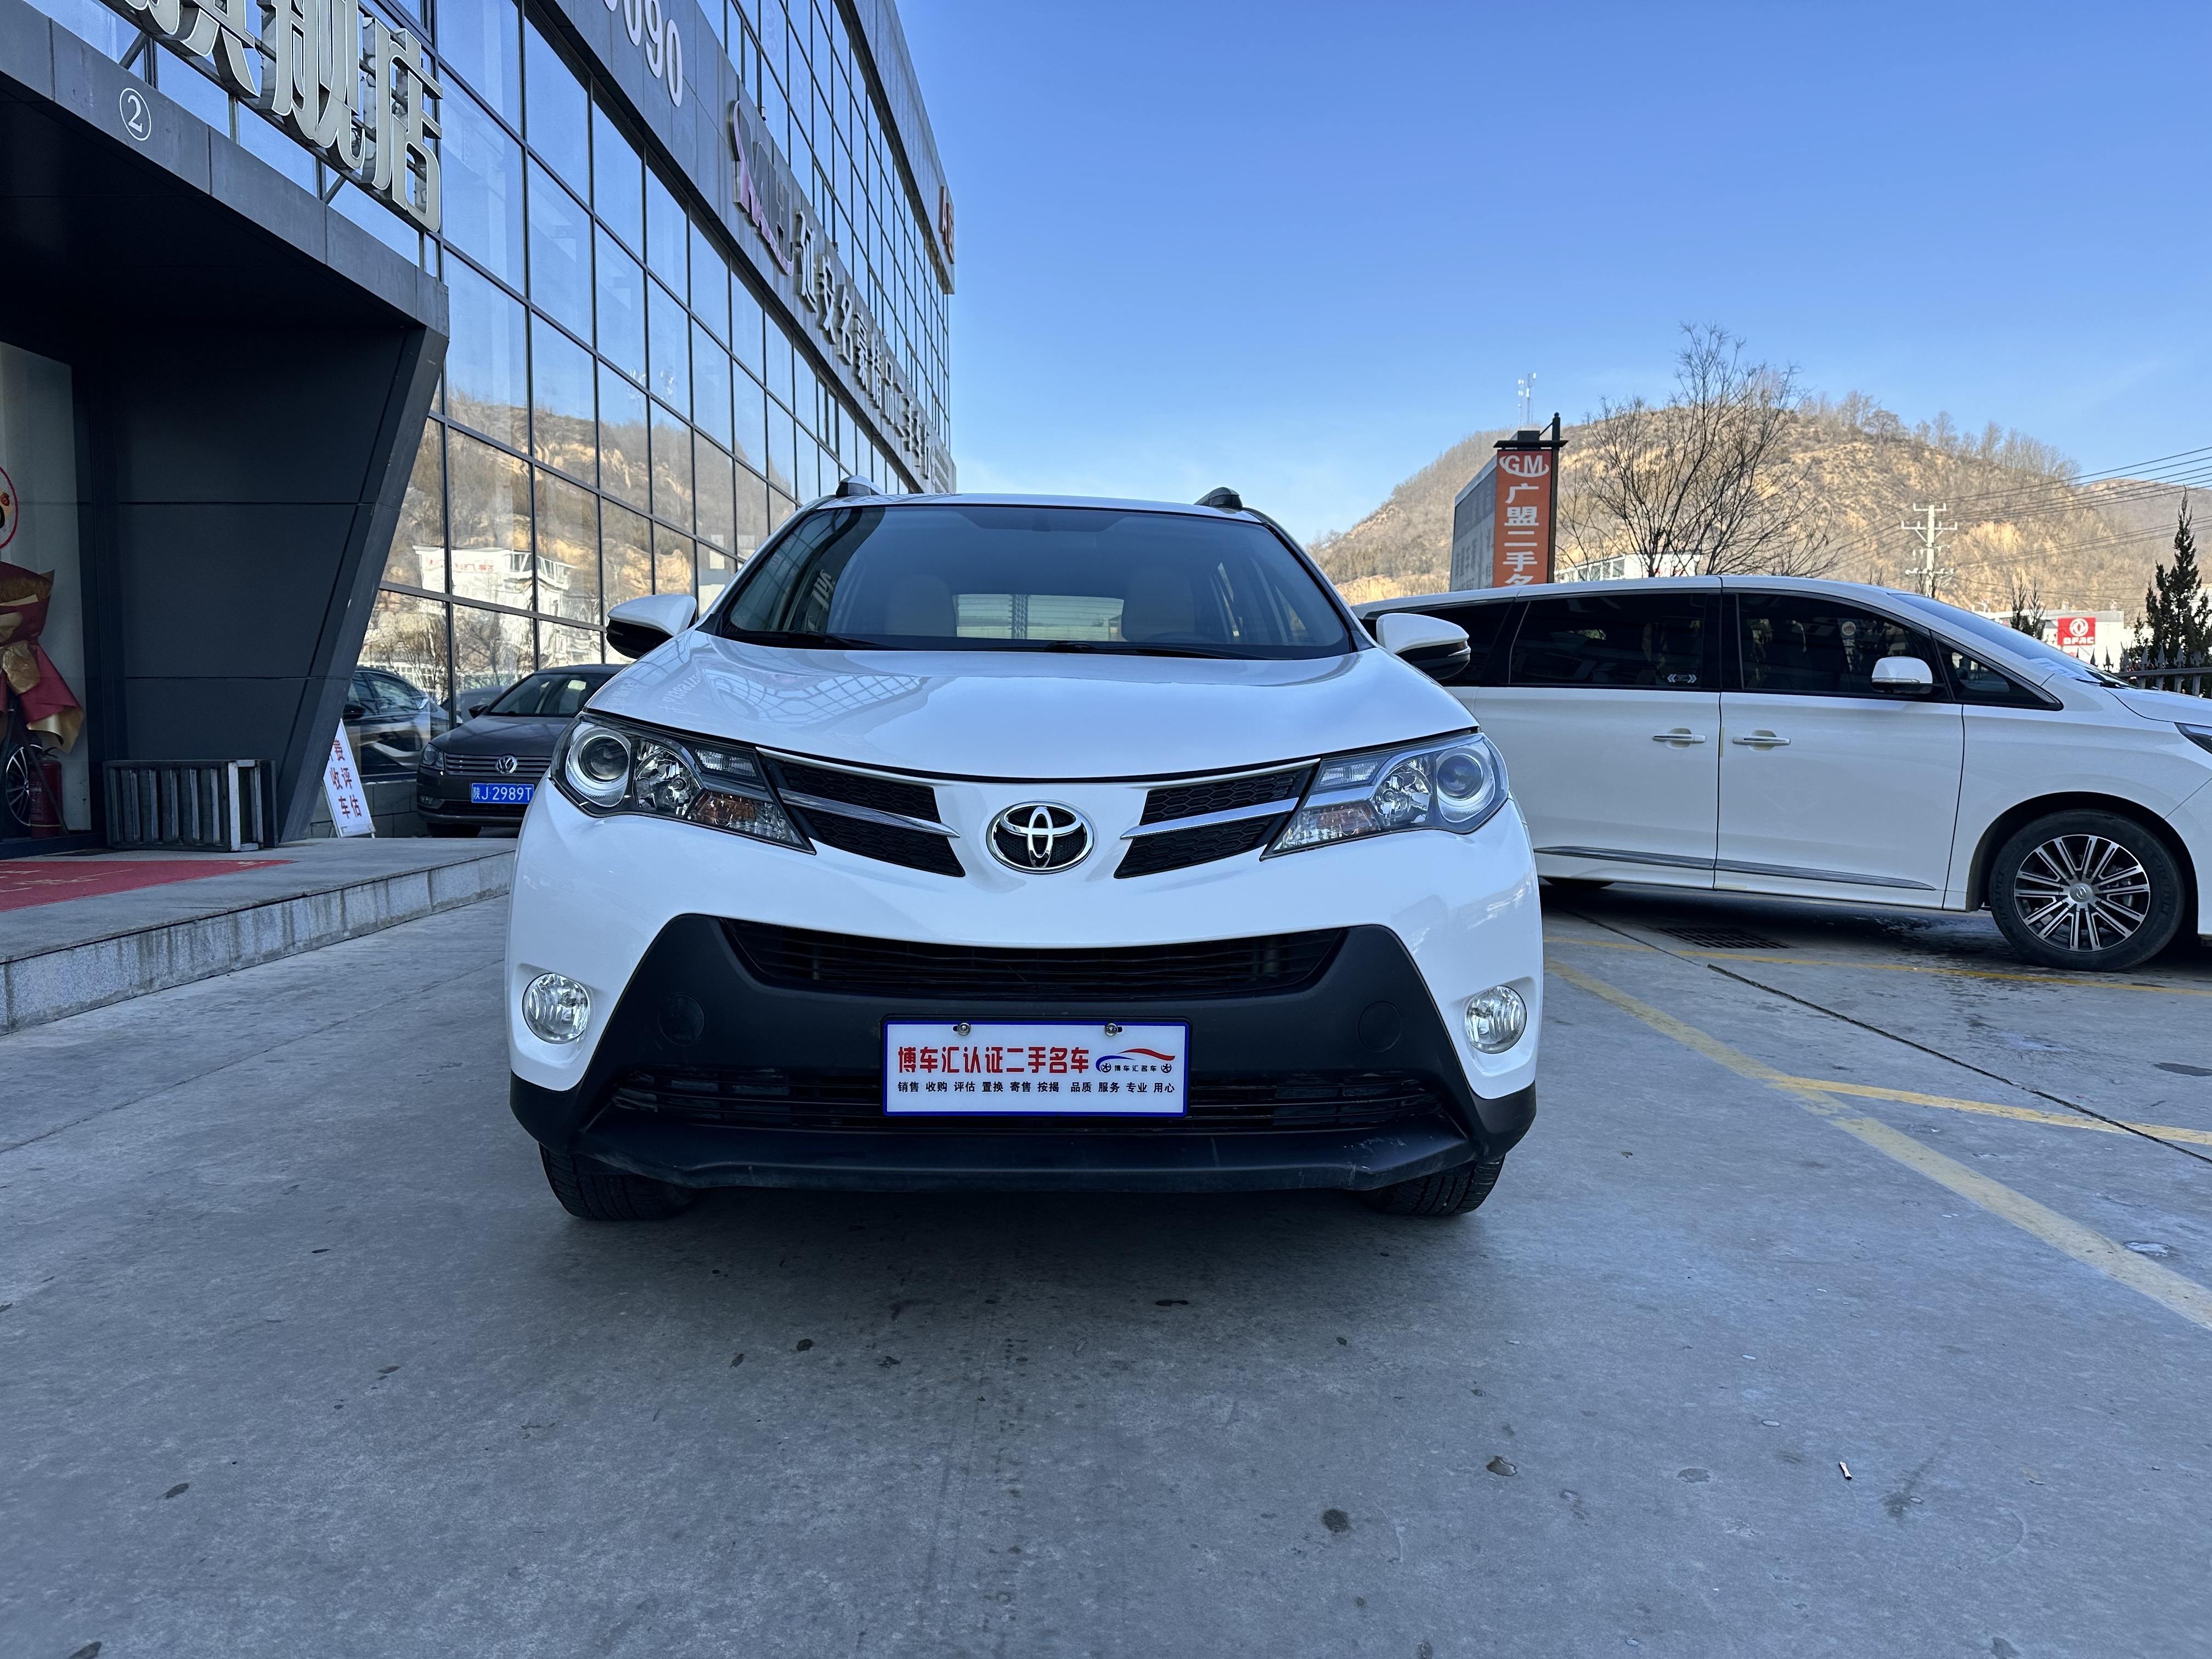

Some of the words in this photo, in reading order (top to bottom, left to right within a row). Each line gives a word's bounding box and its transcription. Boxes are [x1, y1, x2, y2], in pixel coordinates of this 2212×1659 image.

[1505, 454, 1544, 475] GM
[2063, 636, 2095, 645] DFAC
[898, 1046, 1089, 1073] 博车汇认证二手名车
[898, 1081, 919, 1092] 销售
[926, 1081, 947, 1092] 收购
[953, 1081, 975, 1092] 评估
[981, 1081, 1003, 1092] 置换
[1009, 1081, 1031, 1092] 寄售
[1037, 1082, 1059, 1093] 按揭
[1070, 1082, 1092, 1093] 品质
[1098, 1082, 1120, 1093] 服务
[1126, 1082, 1147, 1093] 专业
[1153, 1082, 1175, 1093] 用心
